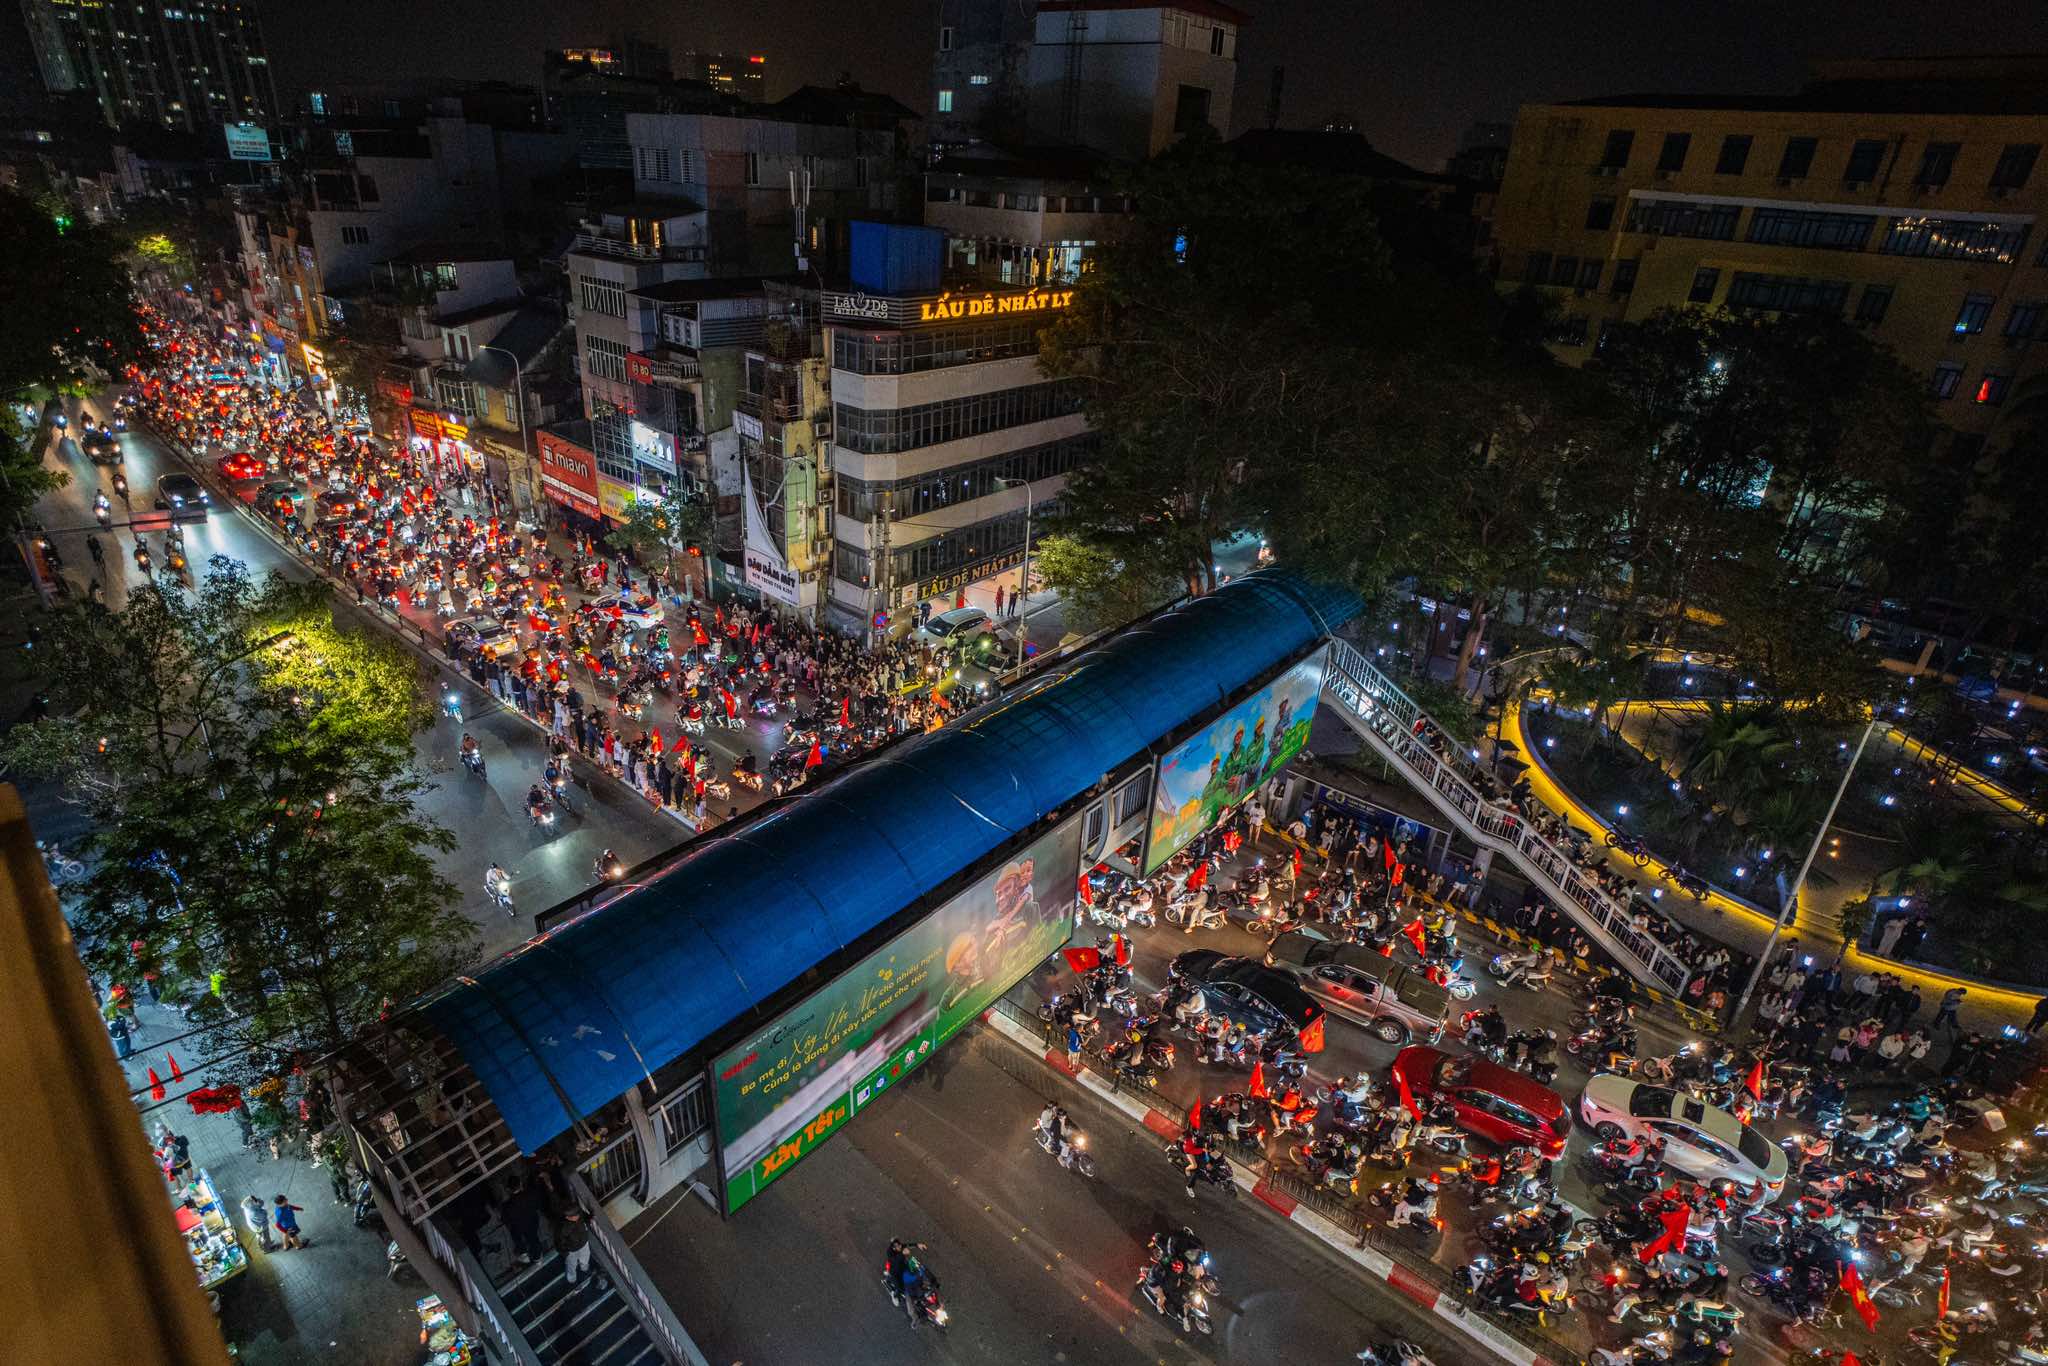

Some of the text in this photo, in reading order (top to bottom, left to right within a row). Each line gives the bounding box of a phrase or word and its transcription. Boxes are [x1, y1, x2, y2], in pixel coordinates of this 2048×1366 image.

[968, 294, 994, 316] DÊ
[998, 287, 1049, 312] NHẤT
[952, 568, 968, 587] DÊ
[792, 1062, 801, 1074] là
[803, 1044, 829, 1065] đang
[831, 1034, 841, 1047] đi
[842, 1022, 861, 1038] xây
[740, 1080, 756, 1096] Ba
[758, 1069, 776, 1085] mẹ
[777, 1056, 788, 1070] đi
